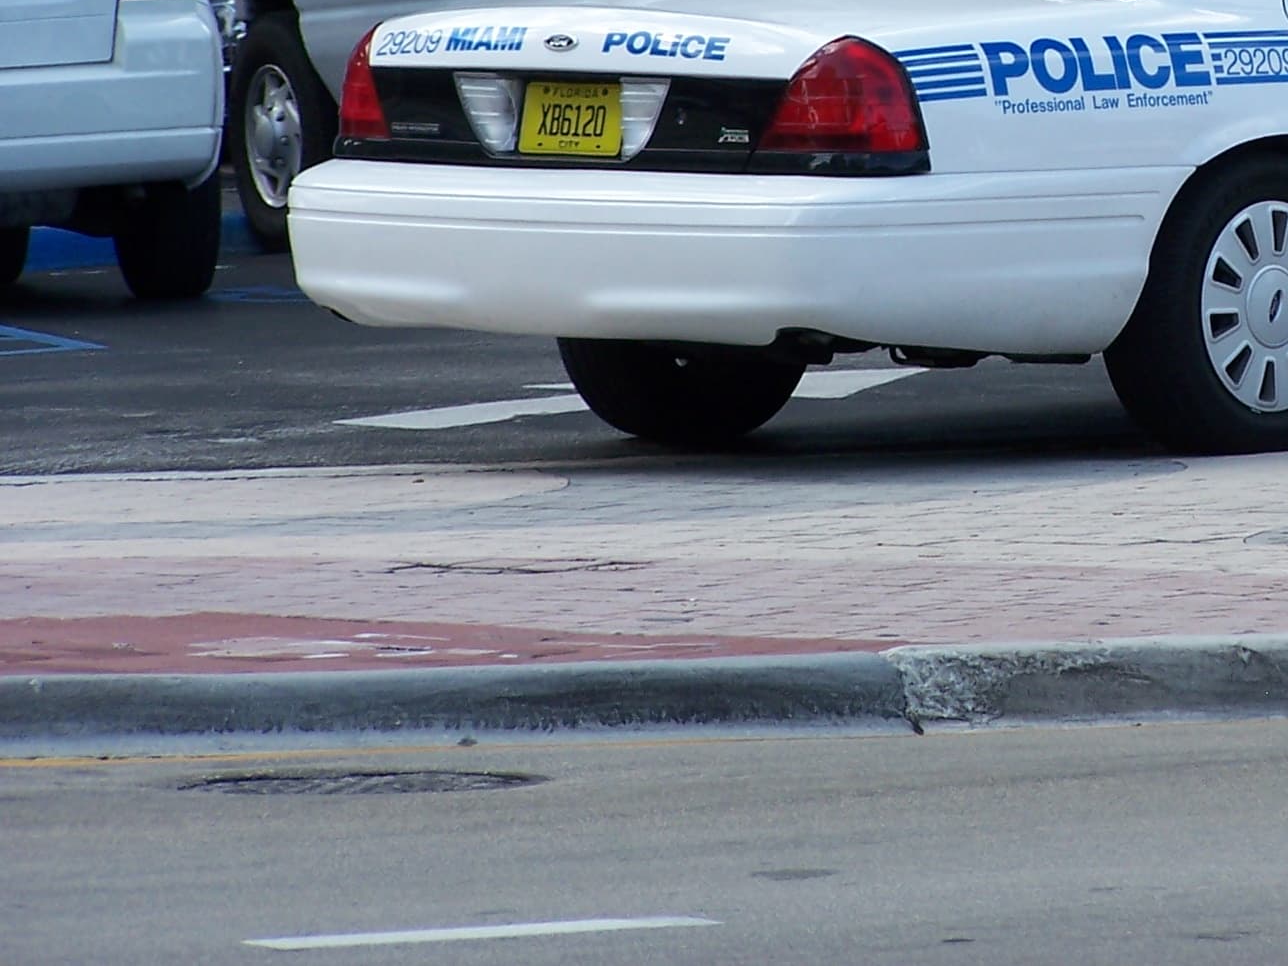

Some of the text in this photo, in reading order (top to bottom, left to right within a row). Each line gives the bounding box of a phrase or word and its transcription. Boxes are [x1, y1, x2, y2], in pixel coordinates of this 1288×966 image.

[376, 28, 443, 57] 29209
[444, 26, 528, 51] MIAMI
[601, 30, 731, 62] POLICE
[980, 33, 1213, 97] POLICE
[1092, 95, 1120, 110] Law
[537, 102, 607, 137] XB6120
[558, 139, 580, 148] CITY
